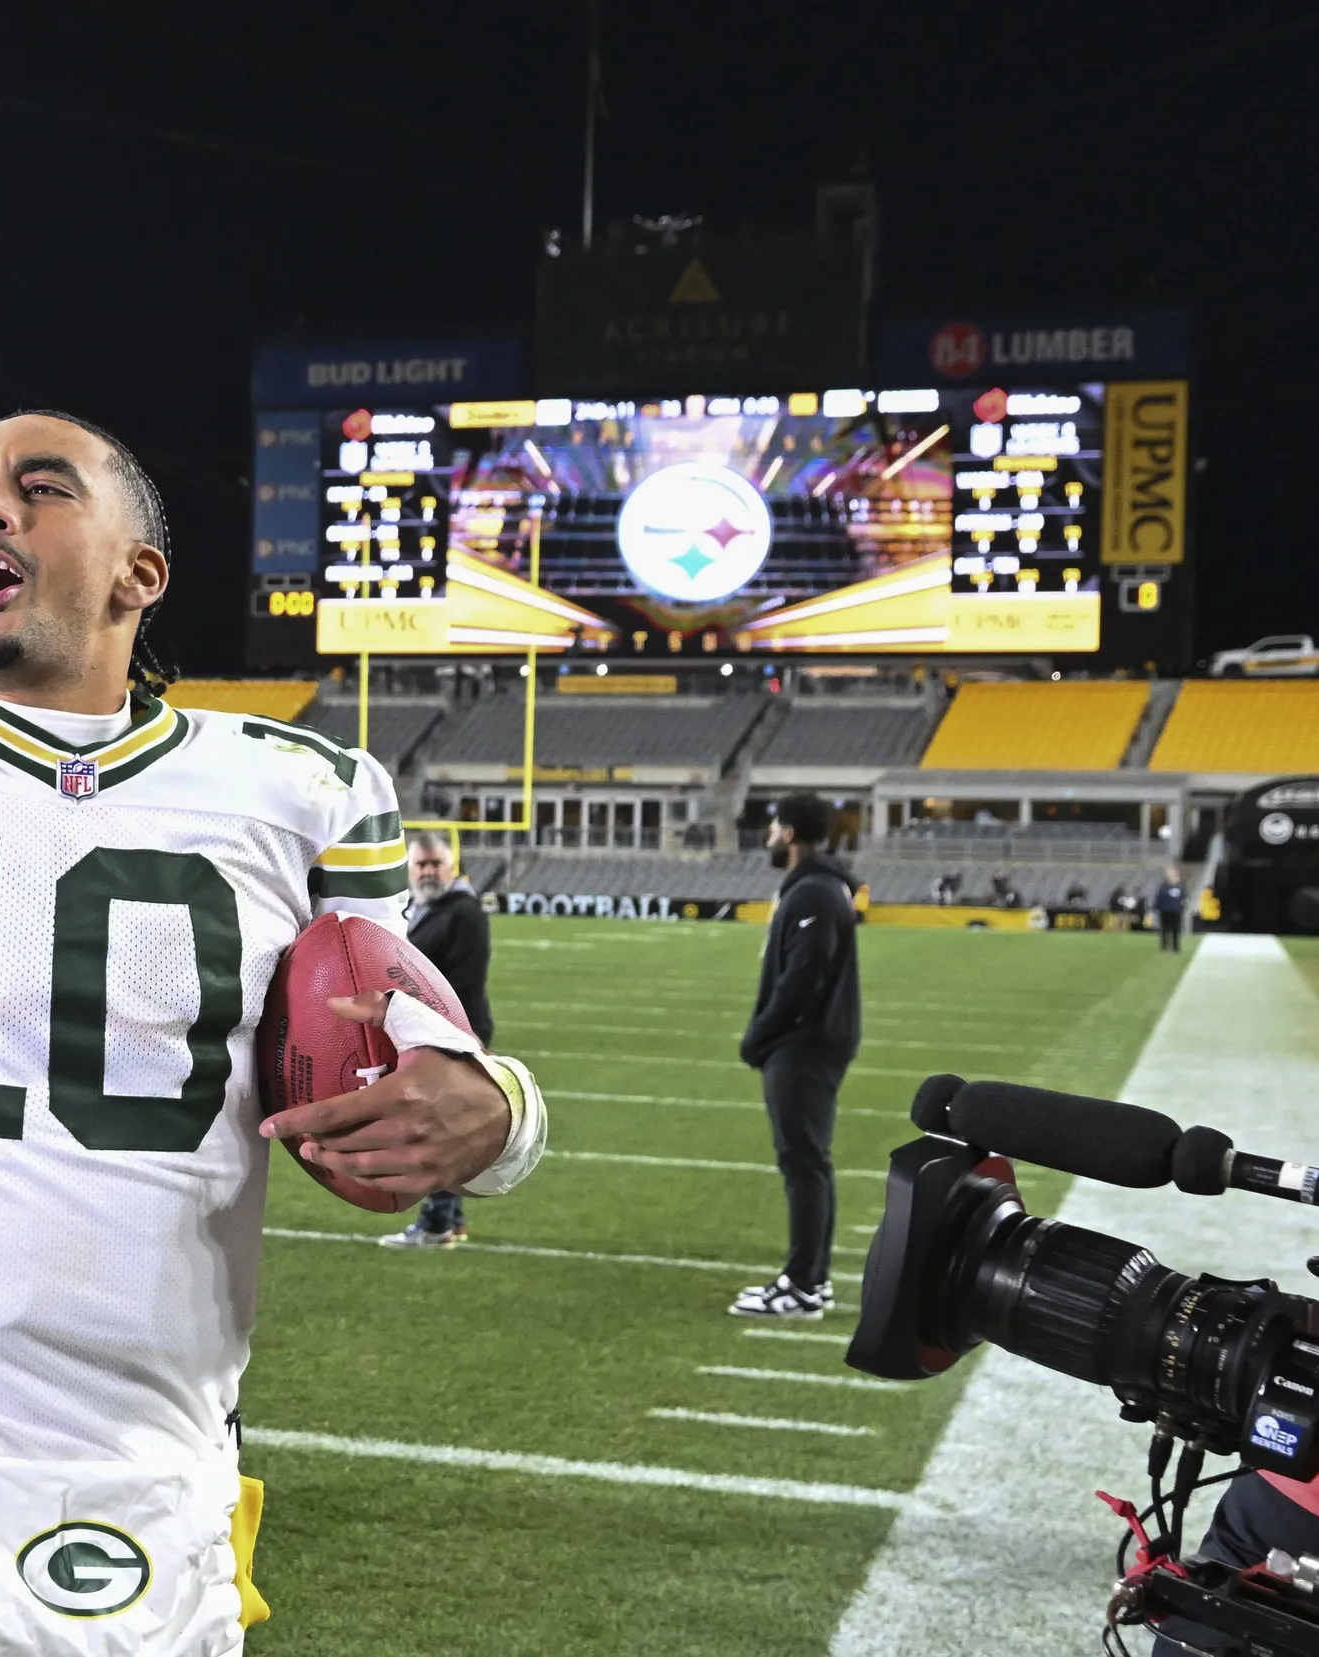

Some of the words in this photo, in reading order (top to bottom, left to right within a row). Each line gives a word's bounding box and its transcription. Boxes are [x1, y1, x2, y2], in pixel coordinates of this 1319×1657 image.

[991, 328, 1134, 364] LUMBER
[307, 361, 372, 387] BUD
[376, 358, 466, 384] LIGHT
[1130, 395, 1177, 552] UPMC
[64, 775, 92, 795] NFL
[507, 892, 678, 921] FOOTBALL
[276, 1017, 287, 1081] NATIONAL
[1274, 1376, 1314, 1396] Canon
[1250, 1435, 1295, 1457] RENTALS
[1267, 1427, 1298, 1446] NEP
